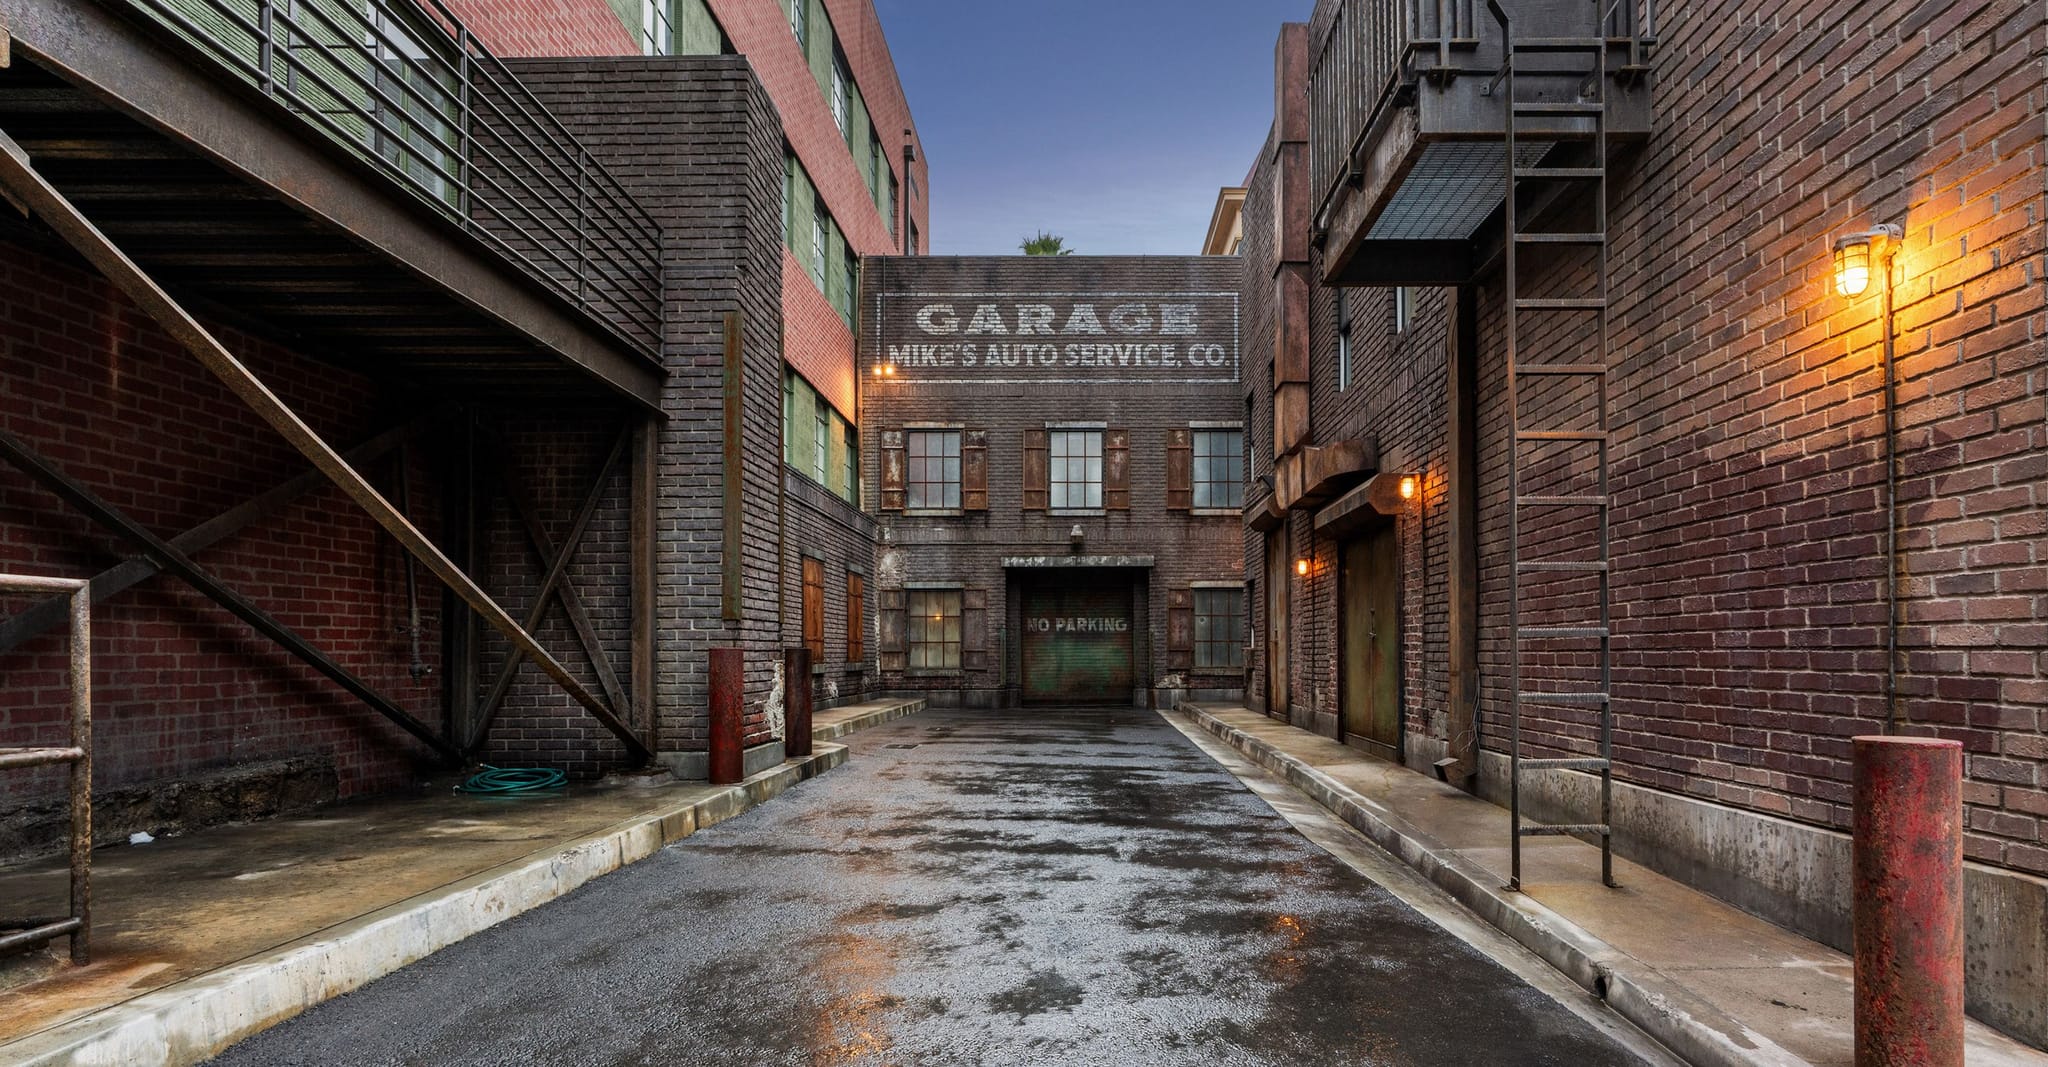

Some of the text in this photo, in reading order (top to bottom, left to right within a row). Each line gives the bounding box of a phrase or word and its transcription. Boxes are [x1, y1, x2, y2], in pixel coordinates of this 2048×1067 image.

[915, 303, 1199, 335] GARAGE
[888, 343, 1230, 368] MIKE'S AUTO SERVICE, CO.
[1027, 617, 1128, 632] NO PARKING
